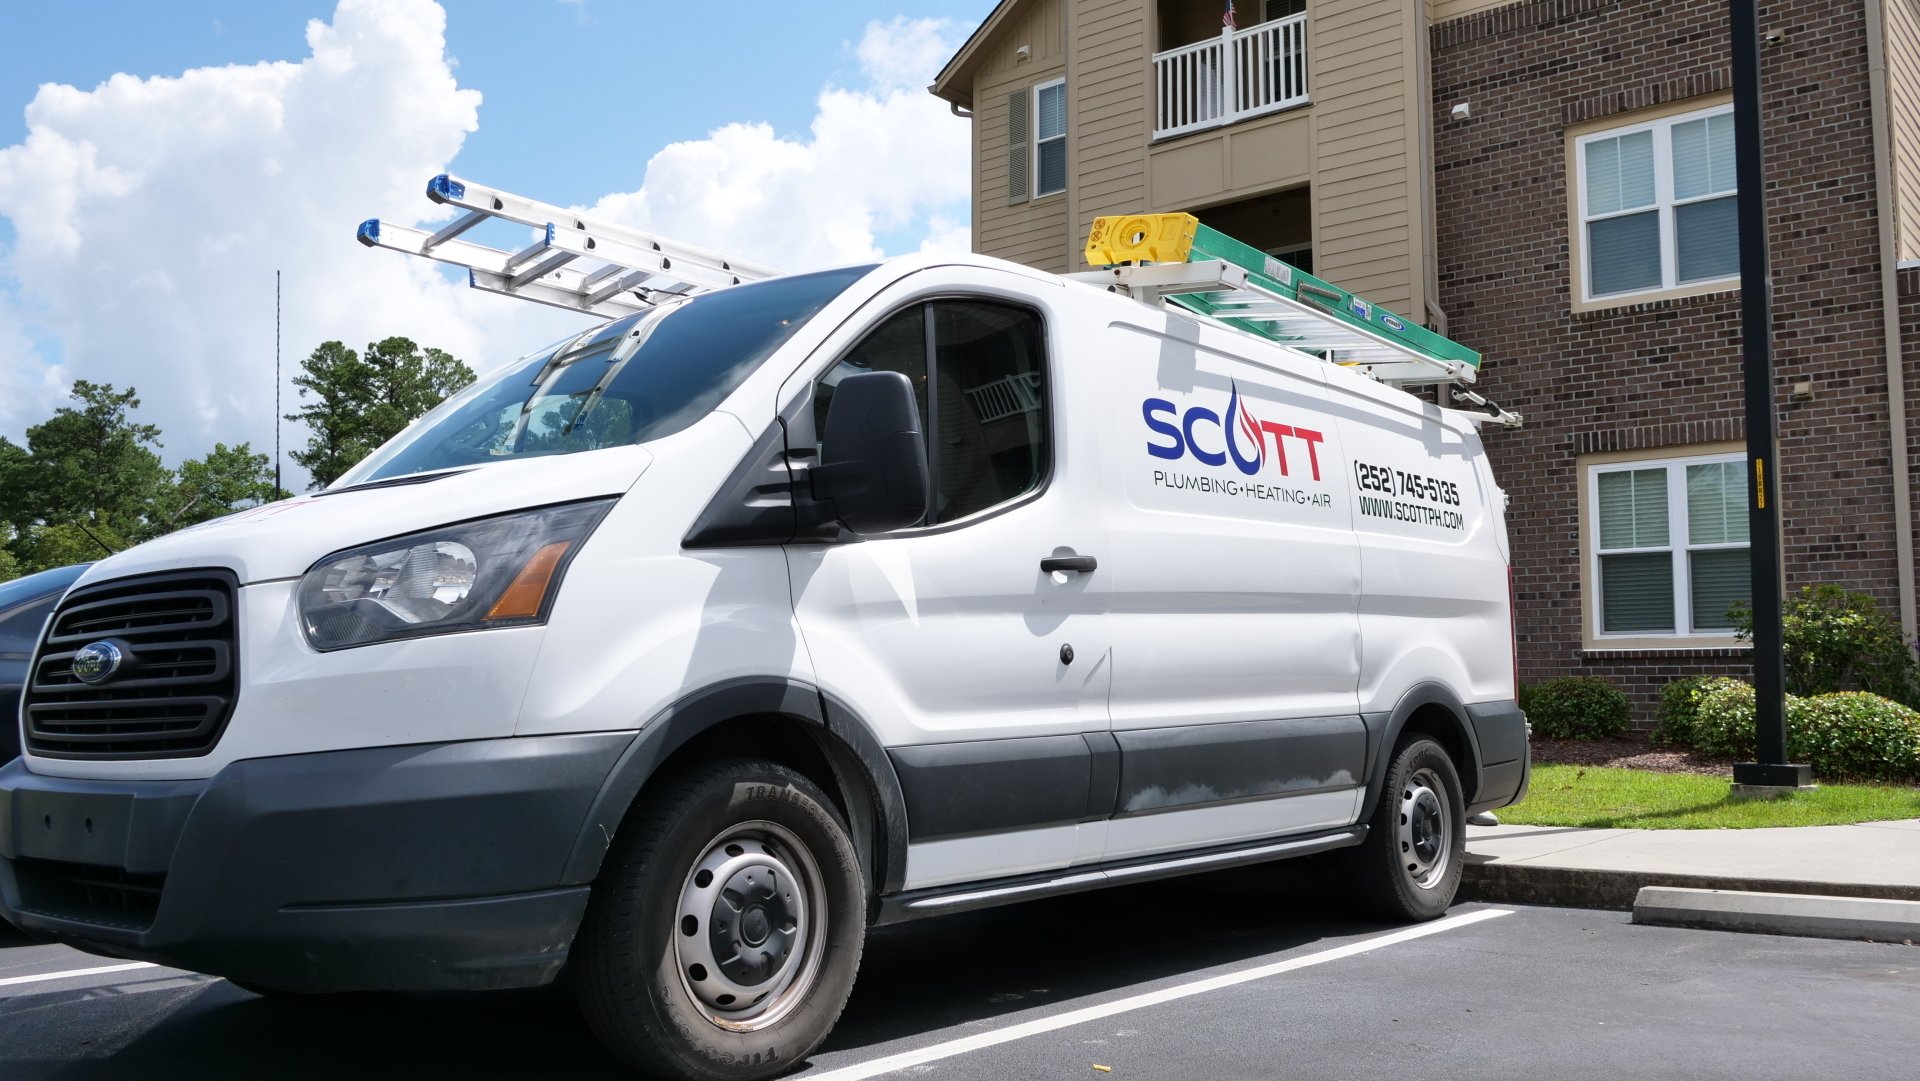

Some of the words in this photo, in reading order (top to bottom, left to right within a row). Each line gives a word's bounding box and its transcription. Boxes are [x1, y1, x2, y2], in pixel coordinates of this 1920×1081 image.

[1142, 376, 1324, 482] SCOTT
[1154, 471, 1237, 496] PLUMBING
[1246, 483, 1306, 504] HEATING
[1312, 491, 1331, 508] AIR
[1354, 460, 1396, 497] (252)
[1397, 471, 1460, 506] 745-5135
[1359, 495, 1464, 530] WWW.SCOTTPH.COM
